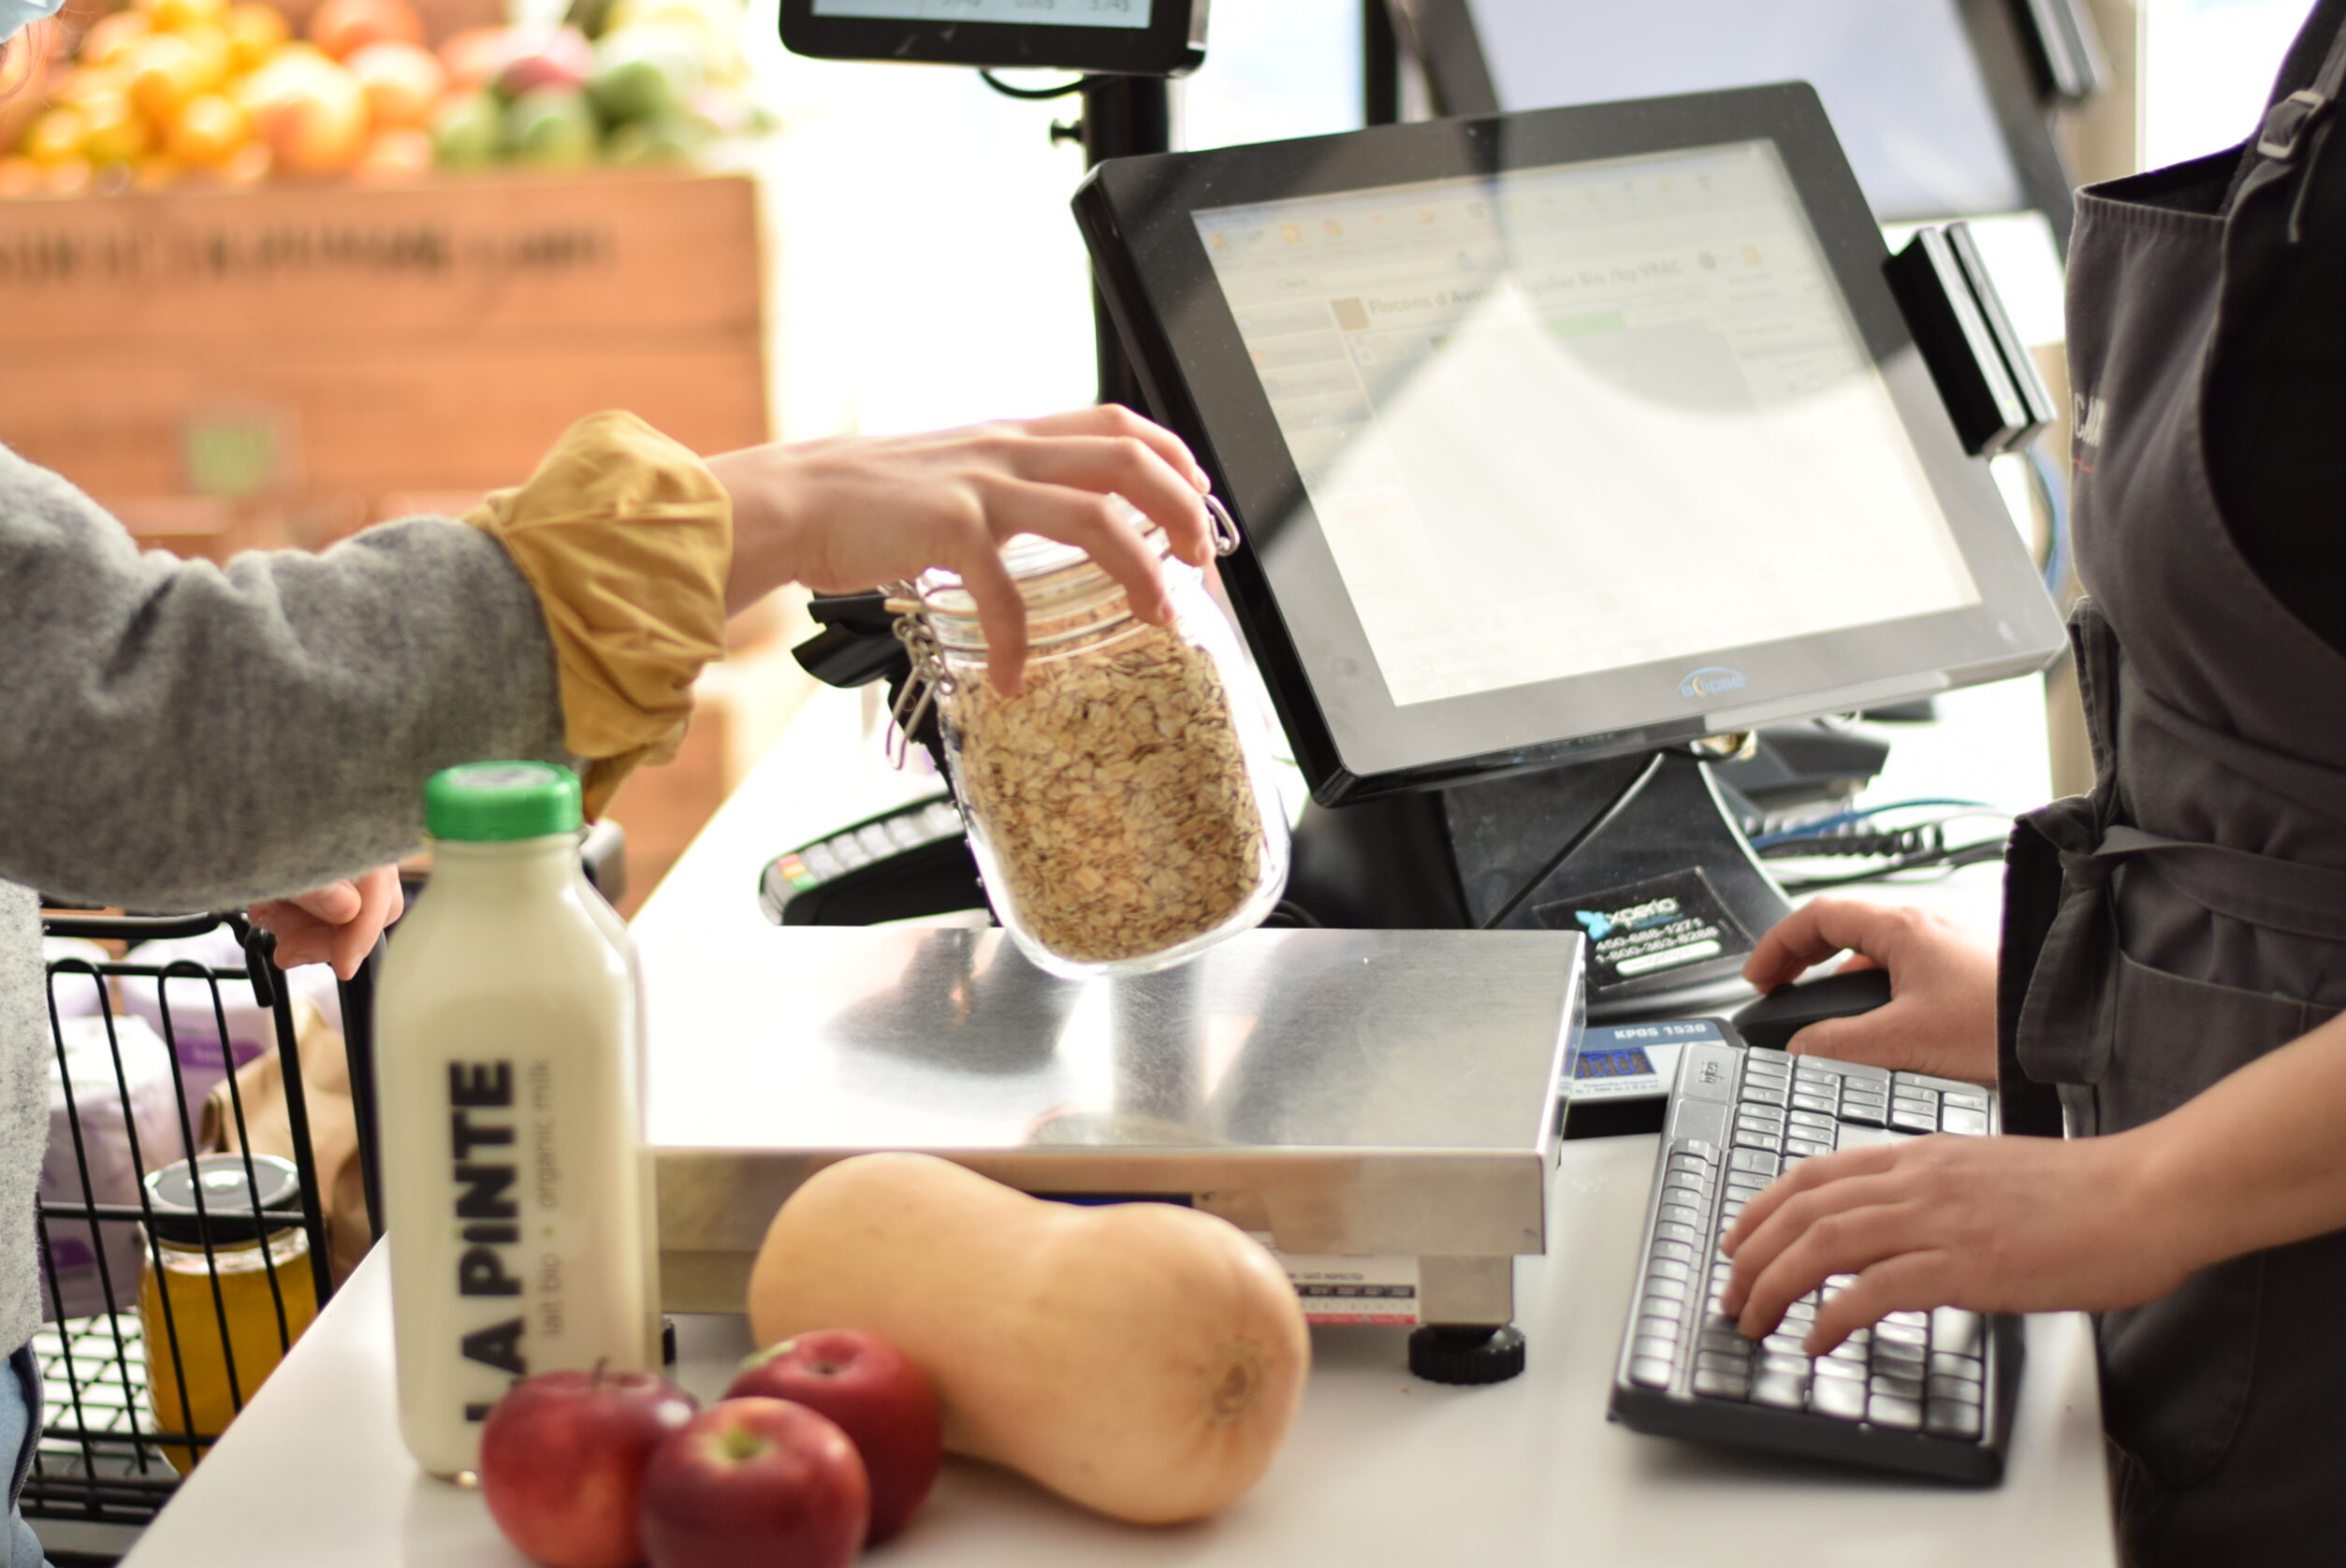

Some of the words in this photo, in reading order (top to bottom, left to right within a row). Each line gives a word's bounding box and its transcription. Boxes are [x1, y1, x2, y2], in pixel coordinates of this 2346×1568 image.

[1637, 256, 1683, 283] VRAC
[526, 1058, 553, 1111] milk
[530, 1119, 560, 1212] organic
[536, 1252, 561, 1297] bio
[539, 1301, 563, 1336] lait
